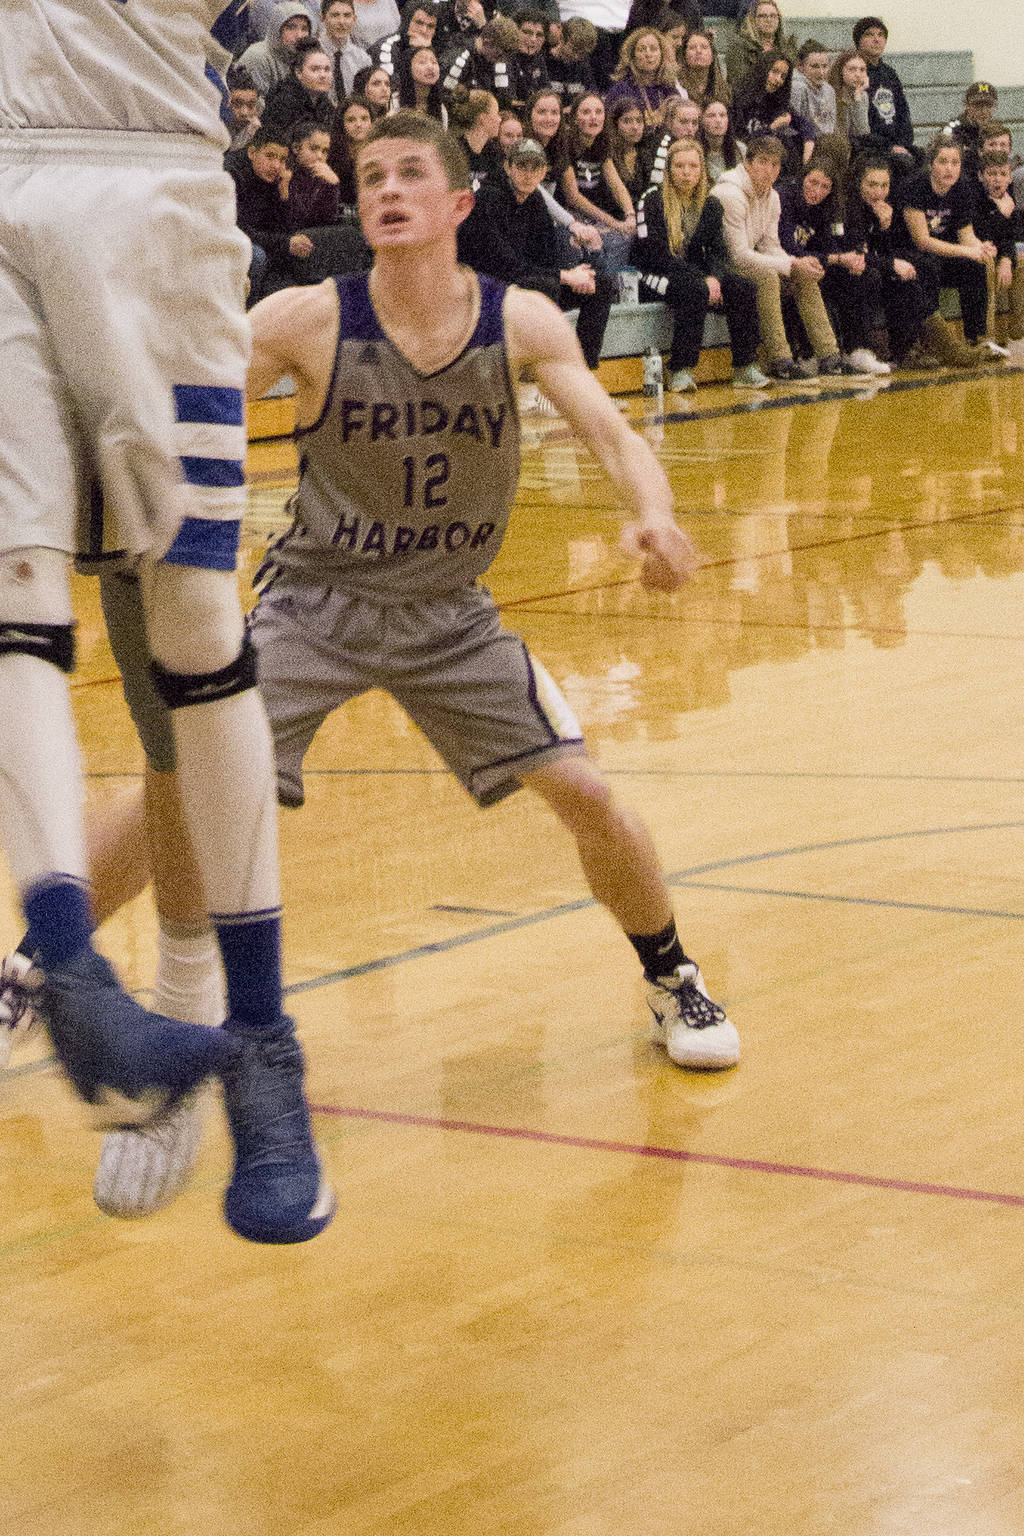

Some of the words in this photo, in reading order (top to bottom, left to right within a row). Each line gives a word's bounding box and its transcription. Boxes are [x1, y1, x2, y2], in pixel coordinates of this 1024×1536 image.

[340, 399, 506, 449] FRIDAY
[403, 452, 451, 509] 12
[331, 514, 496, 556] HARBOR
